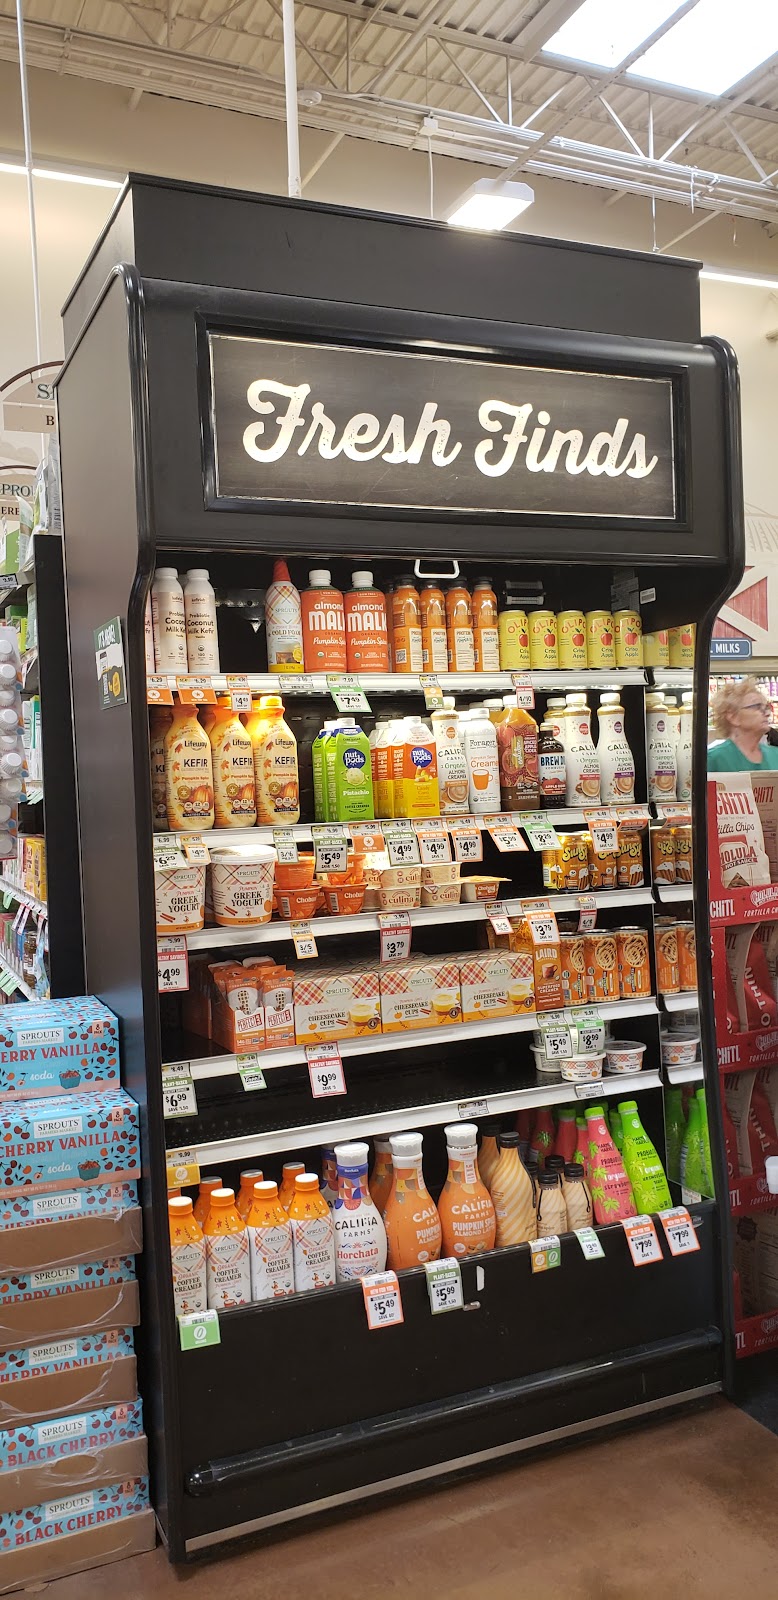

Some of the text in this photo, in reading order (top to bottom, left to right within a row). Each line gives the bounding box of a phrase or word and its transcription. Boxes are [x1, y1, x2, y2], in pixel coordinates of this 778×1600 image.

[242, 378, 658, 479] Fresh Finds
[352, 603, 383, 611] almond
[615, 618, 641, 633] OLIPO
[351, 638, 376, 646] Pumpkin
[716, 643, 740, 653] MILKS
[184, 759, 207, 767] KEFIR
[233, 758, 252, 766] KEFIR
[346, 756, 365, 765] pods
[413, 754, 431, 763] pods
[541, 756, 560, 766] BREW
[736, 822, 755, 832] Chips
[171, 896, 198, 905] GREEK
[231, 899, 263, 907] YOGURT
[389, 896, 414, 904] culina
[168, 904, 200, 912] YOGURT
[744, 908, 769, 918] TORTILLA
[536, 949, 557, 960] LAIRD
[474, 992, 505, 1000] CHEESECAKE
[394, 1001, 428, 1011] CHEESECAKE
[309, 1012, 345, 1022] CHEESECAKE
[21, 1031, 60, 1040] SPROUTS
[1, 1043, 100, 1063] ERRY VANILLA
[30, 1071, 54, 1081] soda
[38, 1121, 79, 1132] SPROUTS
[59, 1131, 120, 1150] VANILLA
[47, 1163, 72, 1174] soda
[37, 1197, 78, 1210] SPROUTS
[465, 1211, 489, 1220] FARMS
[306, 1226, 328, 1235] SPROUTS
[453, 1221, 484, 1231] PUMPKIN
[454, 1229, 481, 1237] ALMOND
[214, 1244, 239, 1252] SPROUTS
[176, 1252, 201, 1261] SPROUTS
[307, 1251, 329, 1259] COFFEE
[338, 1248, 378, 1260] Horchata
[268, 1258, 289, 1267] COFFEE
[305, 1255, 331, 1265] CREAMER
[216, 1268, 239, 1277] COFFEE
[265, 1263, 290, 1273] CREAMER
[35, 1267, 75, 1281] SPROUTS
[214, 1273, 242, 1283] CREAMER
[177, 1277, 200, 1286] COFFEE
[175, 1283, 202, 1292] CREAMER
[33, 1345, 74, 1357] SPROUTS
[42, 1421, 83, 1437] SPROUTS
[7, 1430, 117, 1467] BLACK CHERRY
[49, 1498, 91, 1514] SPROUTS
[15, 1504, 123, 1546] BLACK CHERRY
